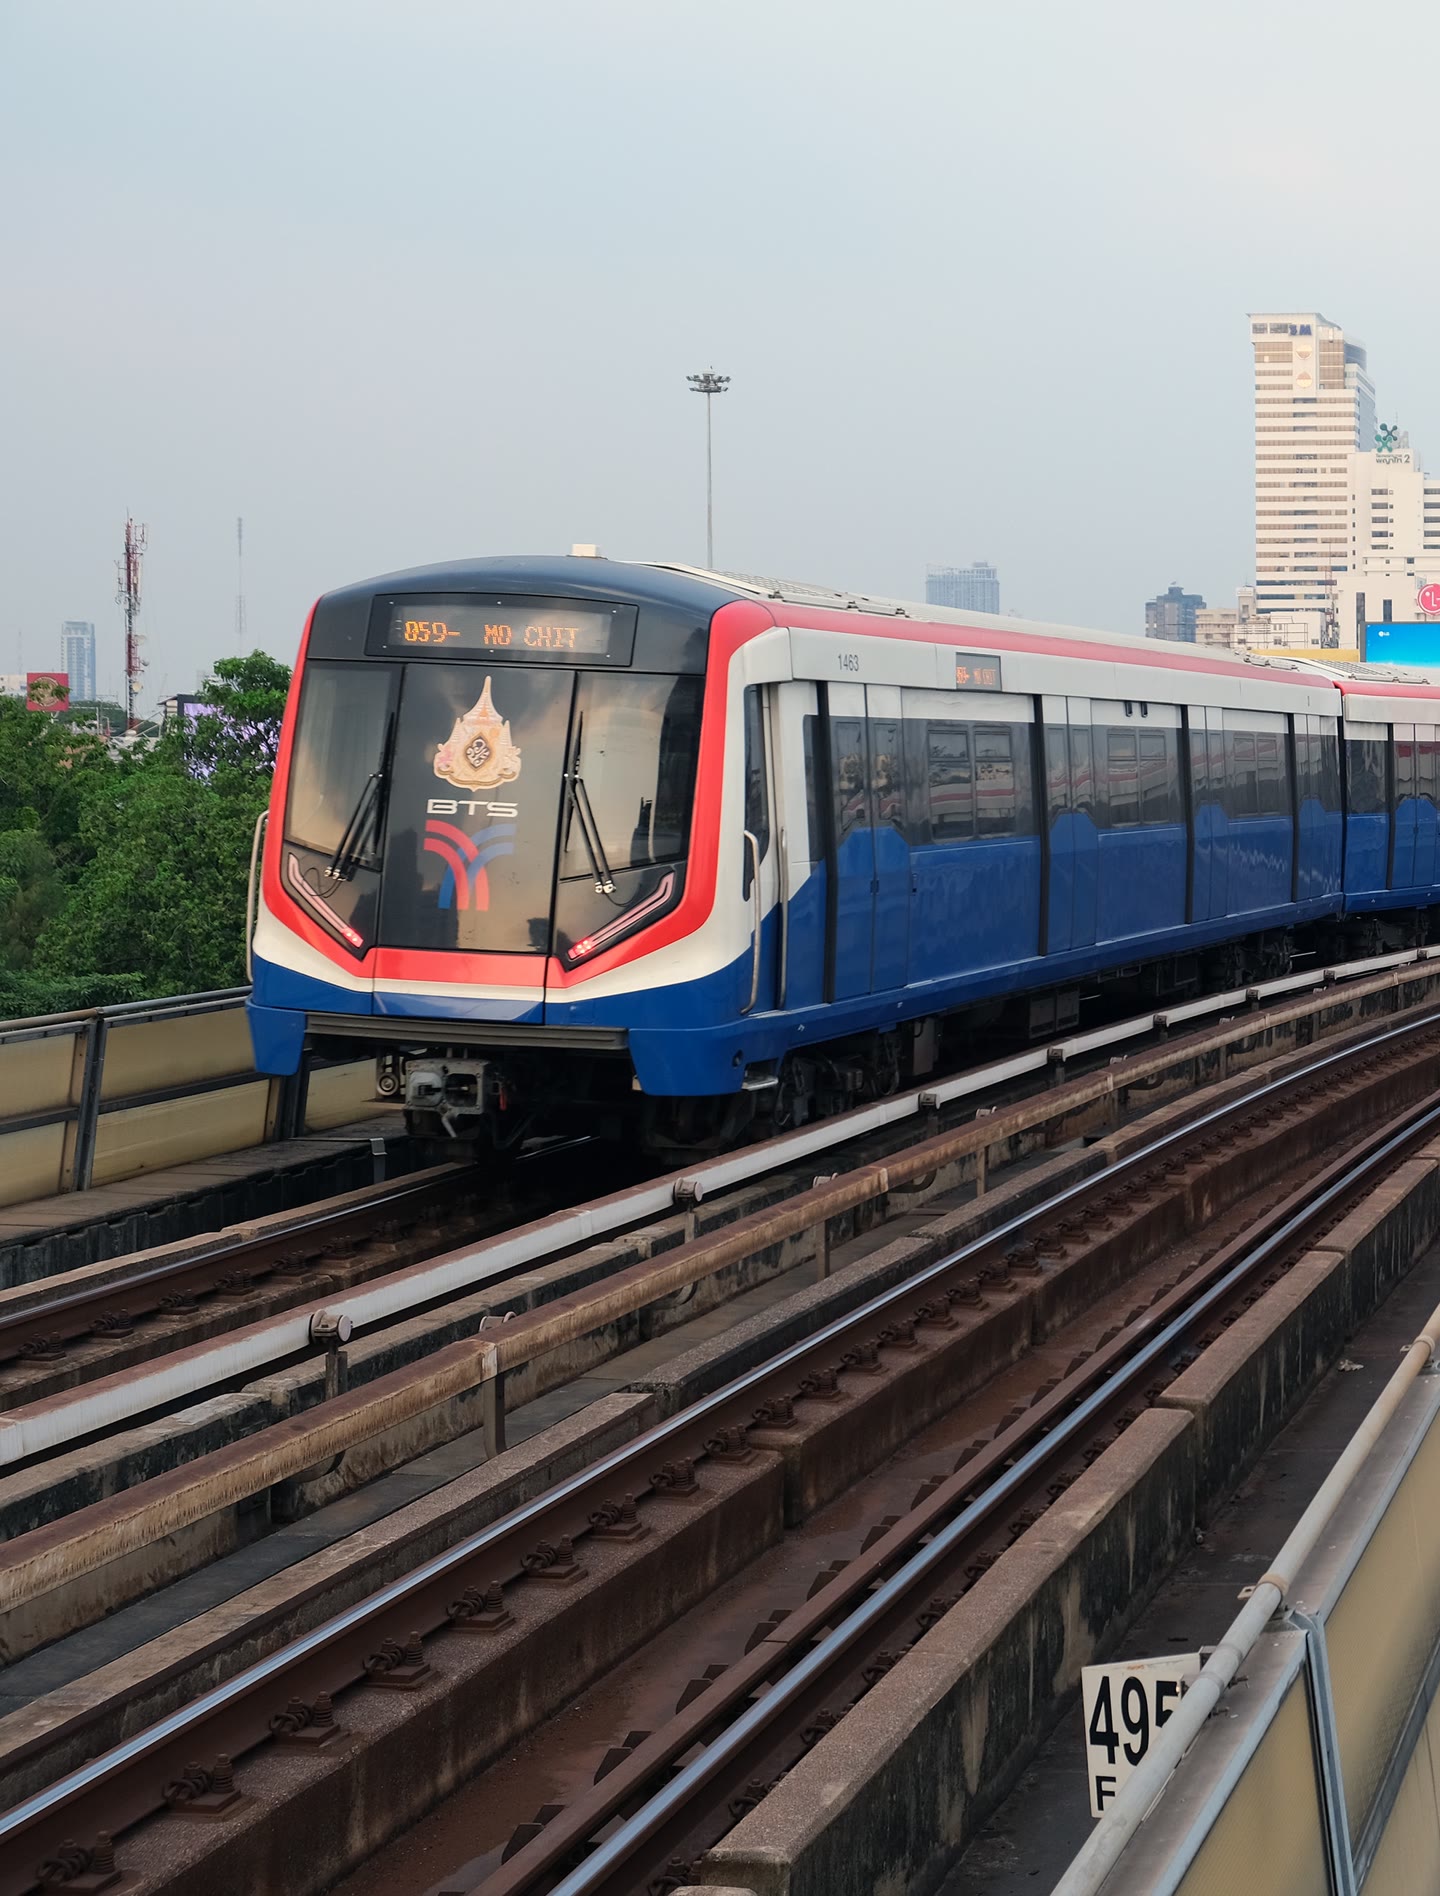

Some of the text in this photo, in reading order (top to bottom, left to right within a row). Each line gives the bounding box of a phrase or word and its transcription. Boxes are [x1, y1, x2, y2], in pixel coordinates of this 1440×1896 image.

[484, 624, 512, 646] MO
[523, 626, 580, 648] CHIT
[838, 653, 859, 672] 1463
[426, 799, 519, 818] BTS
